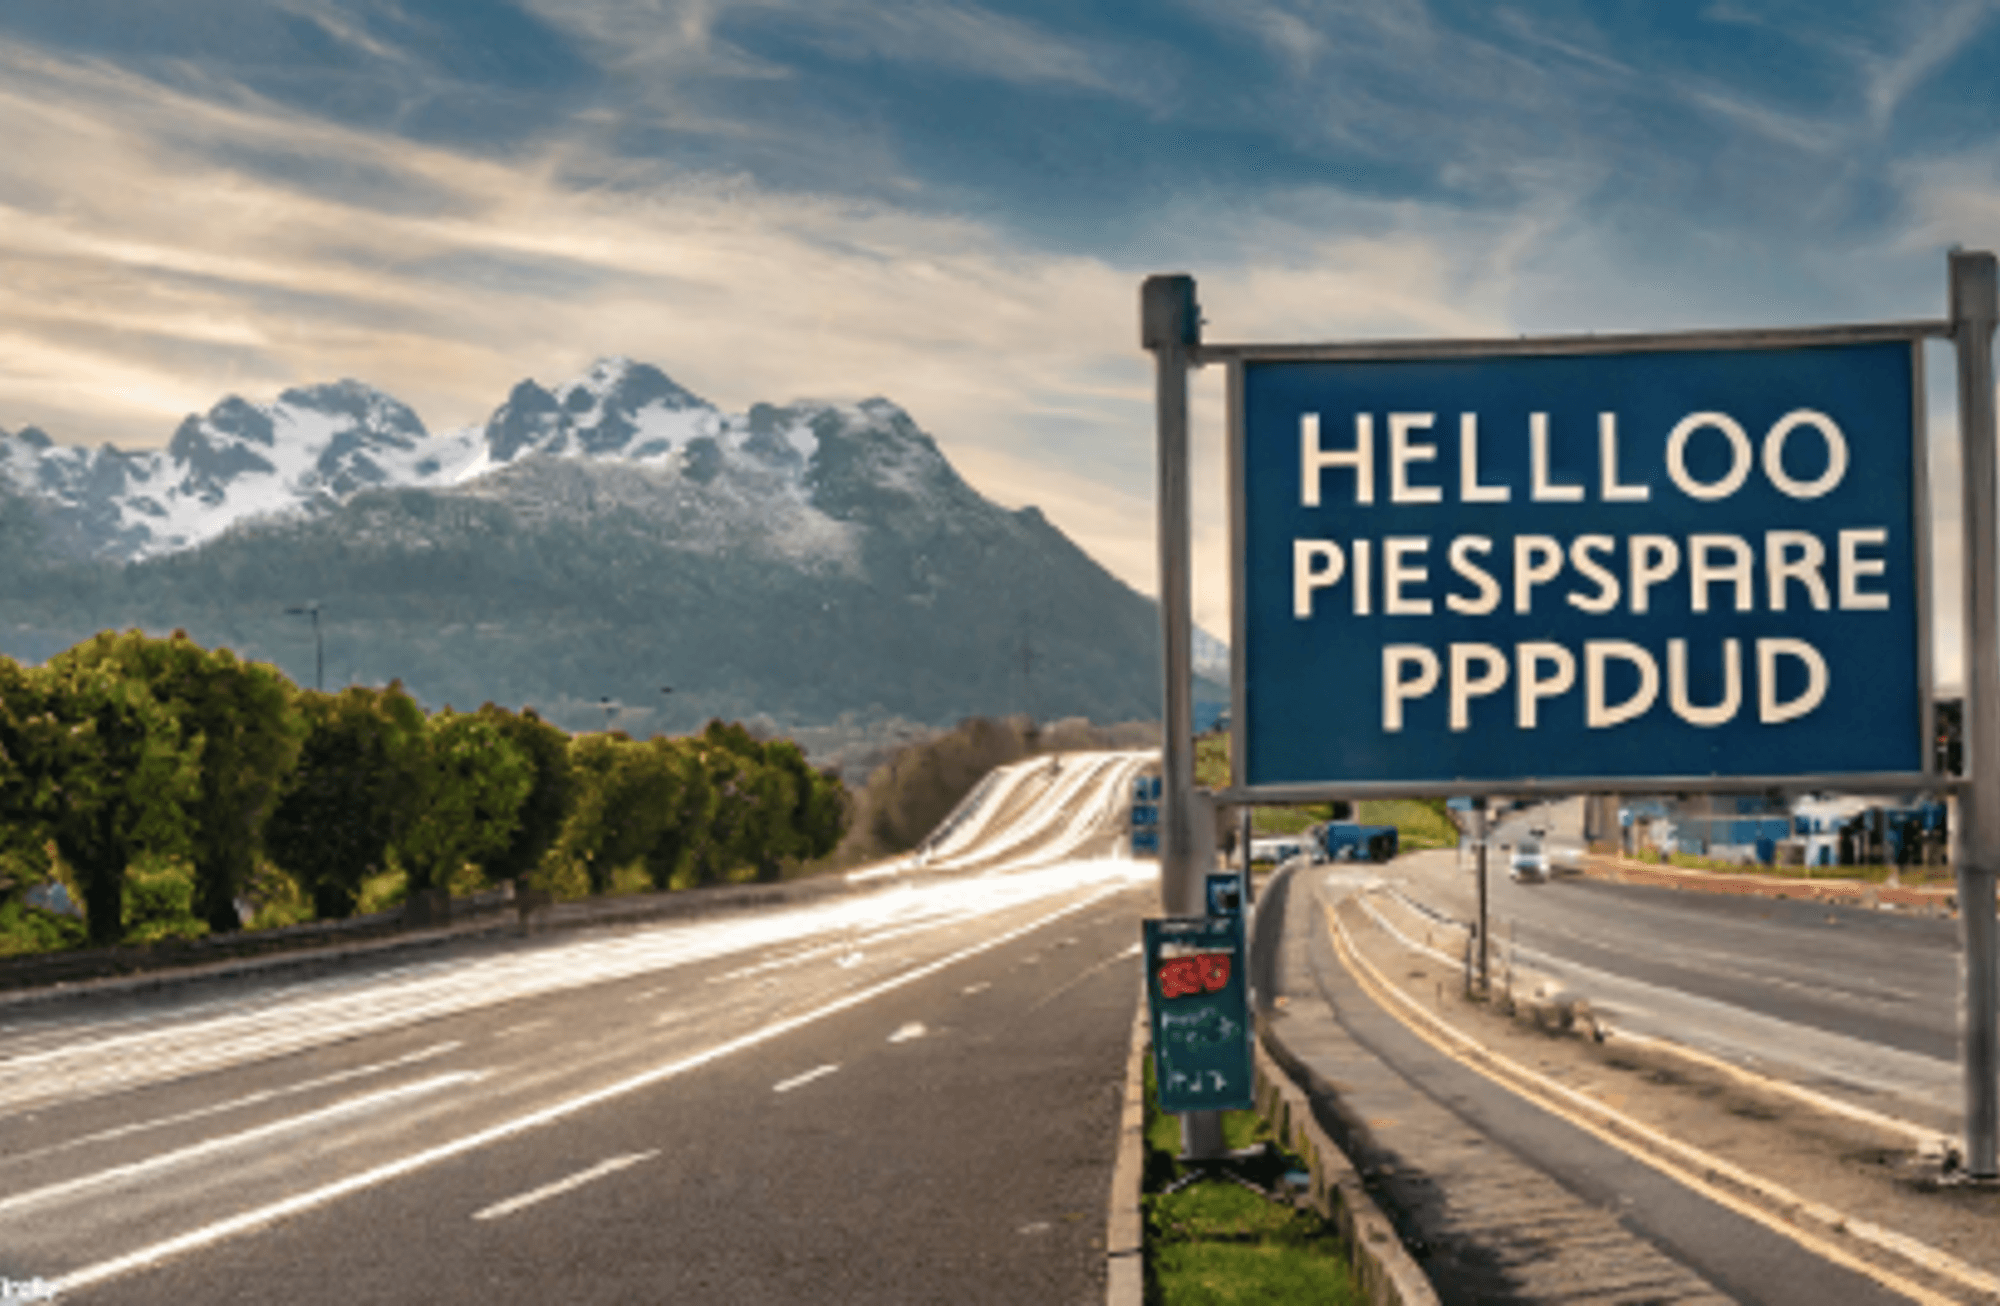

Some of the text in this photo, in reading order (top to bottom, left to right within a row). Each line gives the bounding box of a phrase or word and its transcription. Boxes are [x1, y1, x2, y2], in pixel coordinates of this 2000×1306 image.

[1301, 409, 1849, 507] HELLLOO
[1293, 528, 1890, 618] PIESPSPARE
[1382, 638, 1829, 732] PPPDUD
